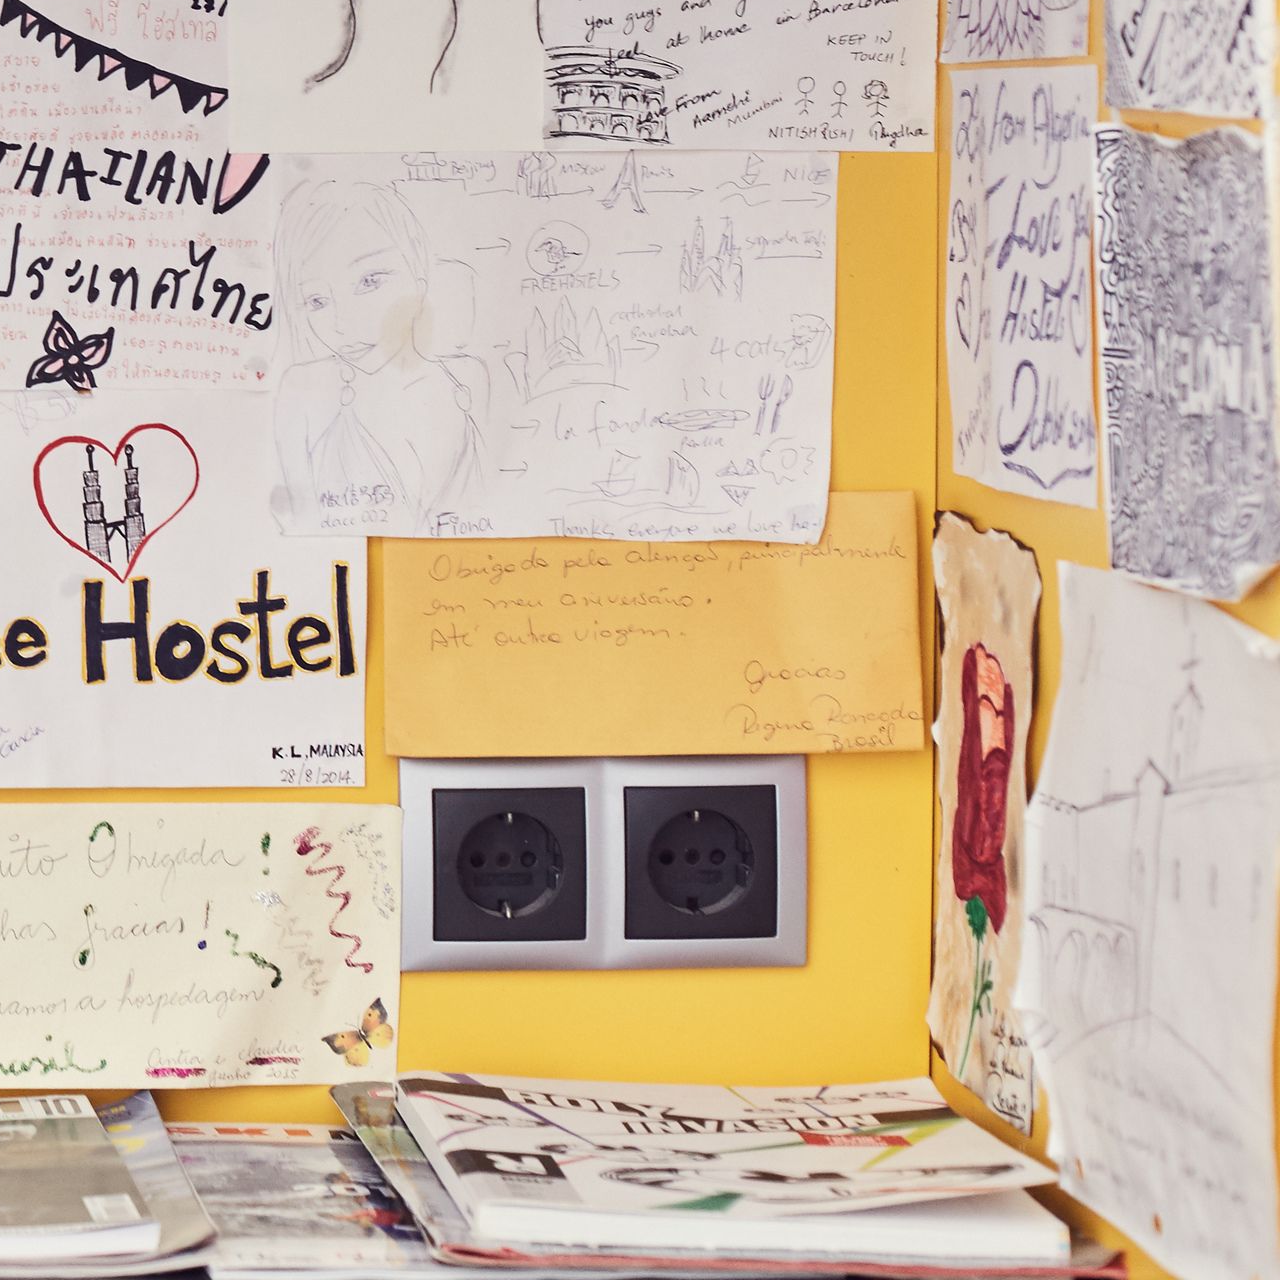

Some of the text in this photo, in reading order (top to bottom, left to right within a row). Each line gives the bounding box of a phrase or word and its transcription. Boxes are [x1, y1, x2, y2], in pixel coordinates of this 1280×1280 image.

[826, 33, 867, 47] KEEP
[80, 561, 359, 685] Hostel
[309, 743, 364, 758] MALAYSIA
[620, 1112, 880, 1136] INVASION
